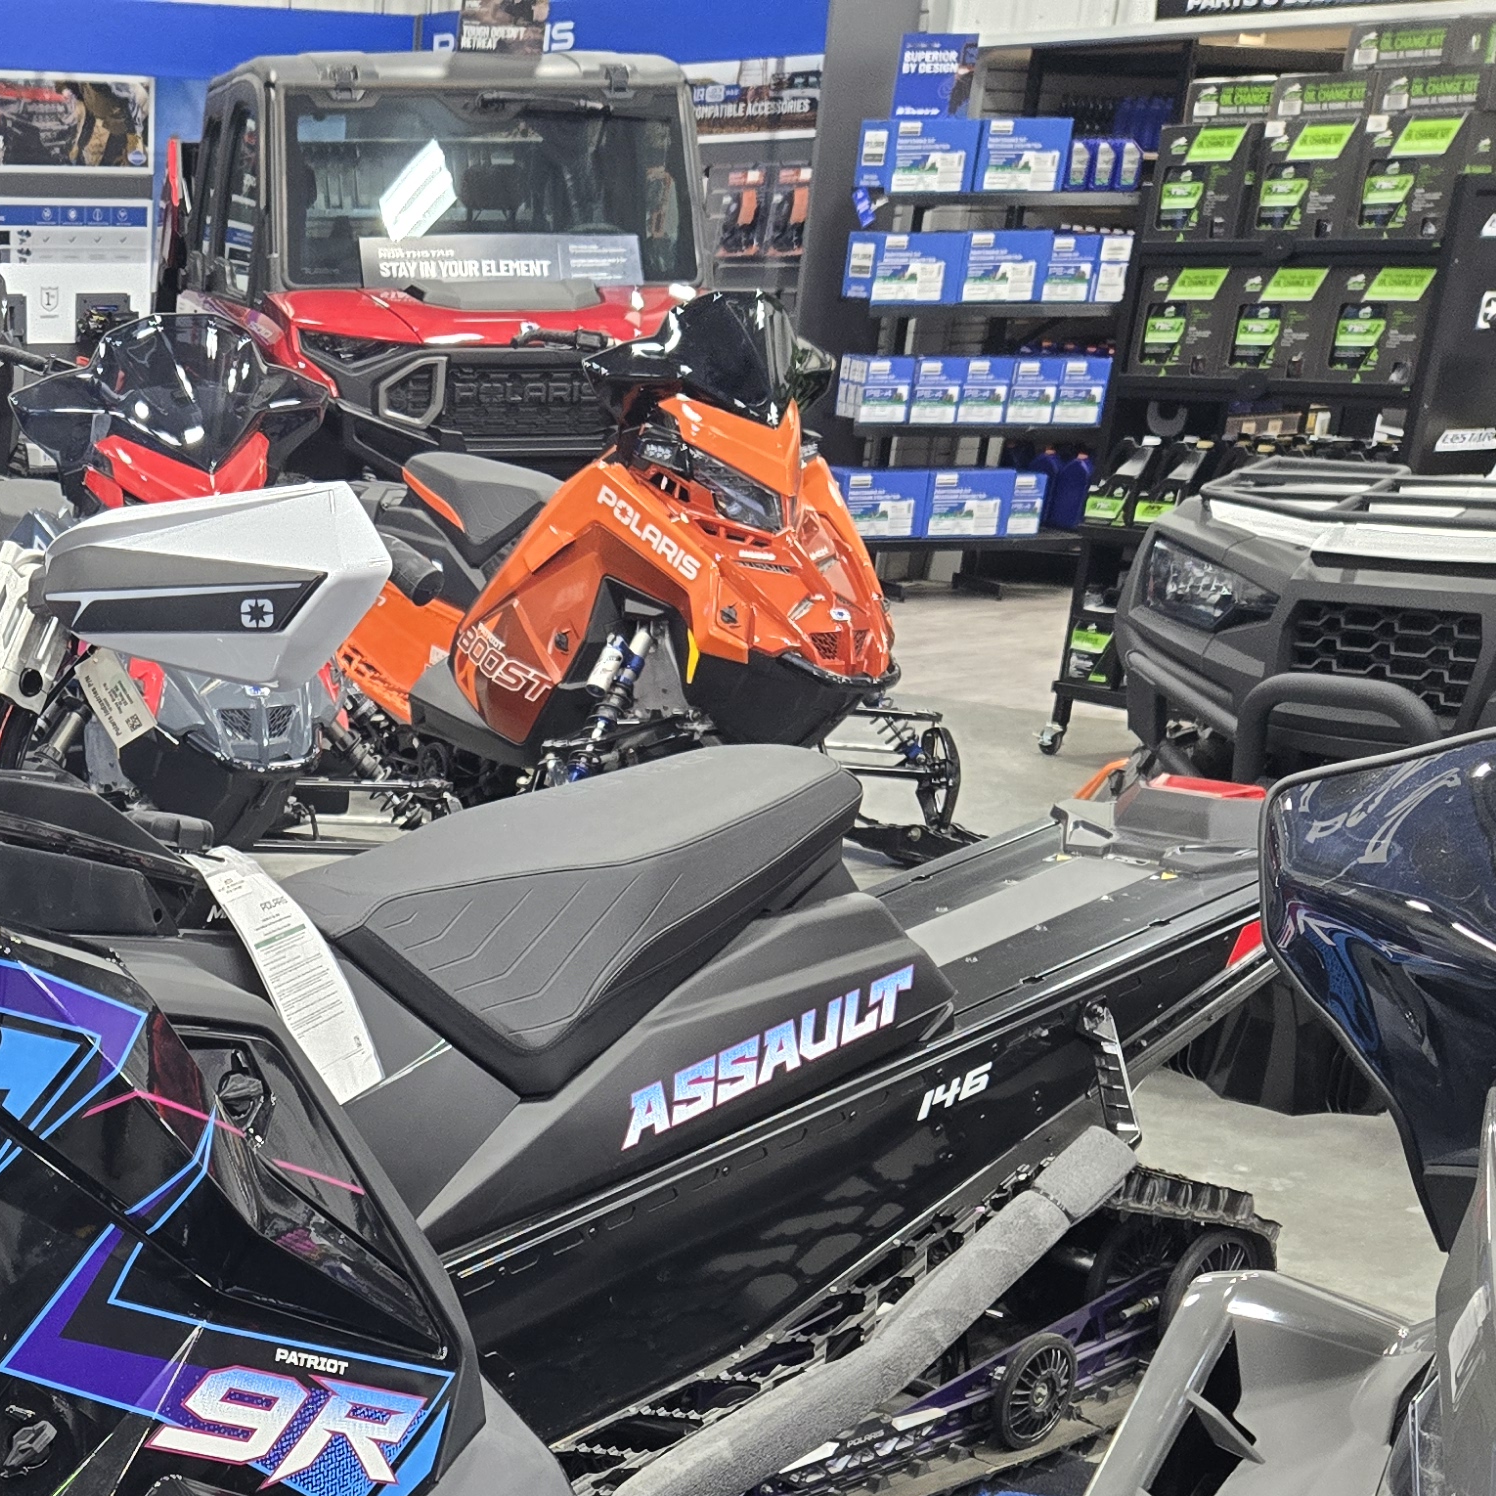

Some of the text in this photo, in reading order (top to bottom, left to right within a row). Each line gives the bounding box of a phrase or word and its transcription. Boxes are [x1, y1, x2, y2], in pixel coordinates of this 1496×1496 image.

[902, 62, 959, 74] BY DESIGN
[904, 51, 958, 63] SUPERIOR
[746, 99, 810, 117] ACCESSORIES
[380, 261, 416, 278] STAY
[420, 261, 437, 278] IN
[438, 260, 480, 277] YOUR
[482, 259, 551, 277] ELEMENT
[597, 484, 702, 581] POLARIS
[457, 626, 554, 702] BOOST
[621, 964, 914, 1151] ASSAULT
[916, 1061, 994, 1122] 146
[275, 1348, 348, 1375] PATRIOT
[143, 1364, 429, 1491] 9R
[847, 1429, 884, 1448] POLARIS
